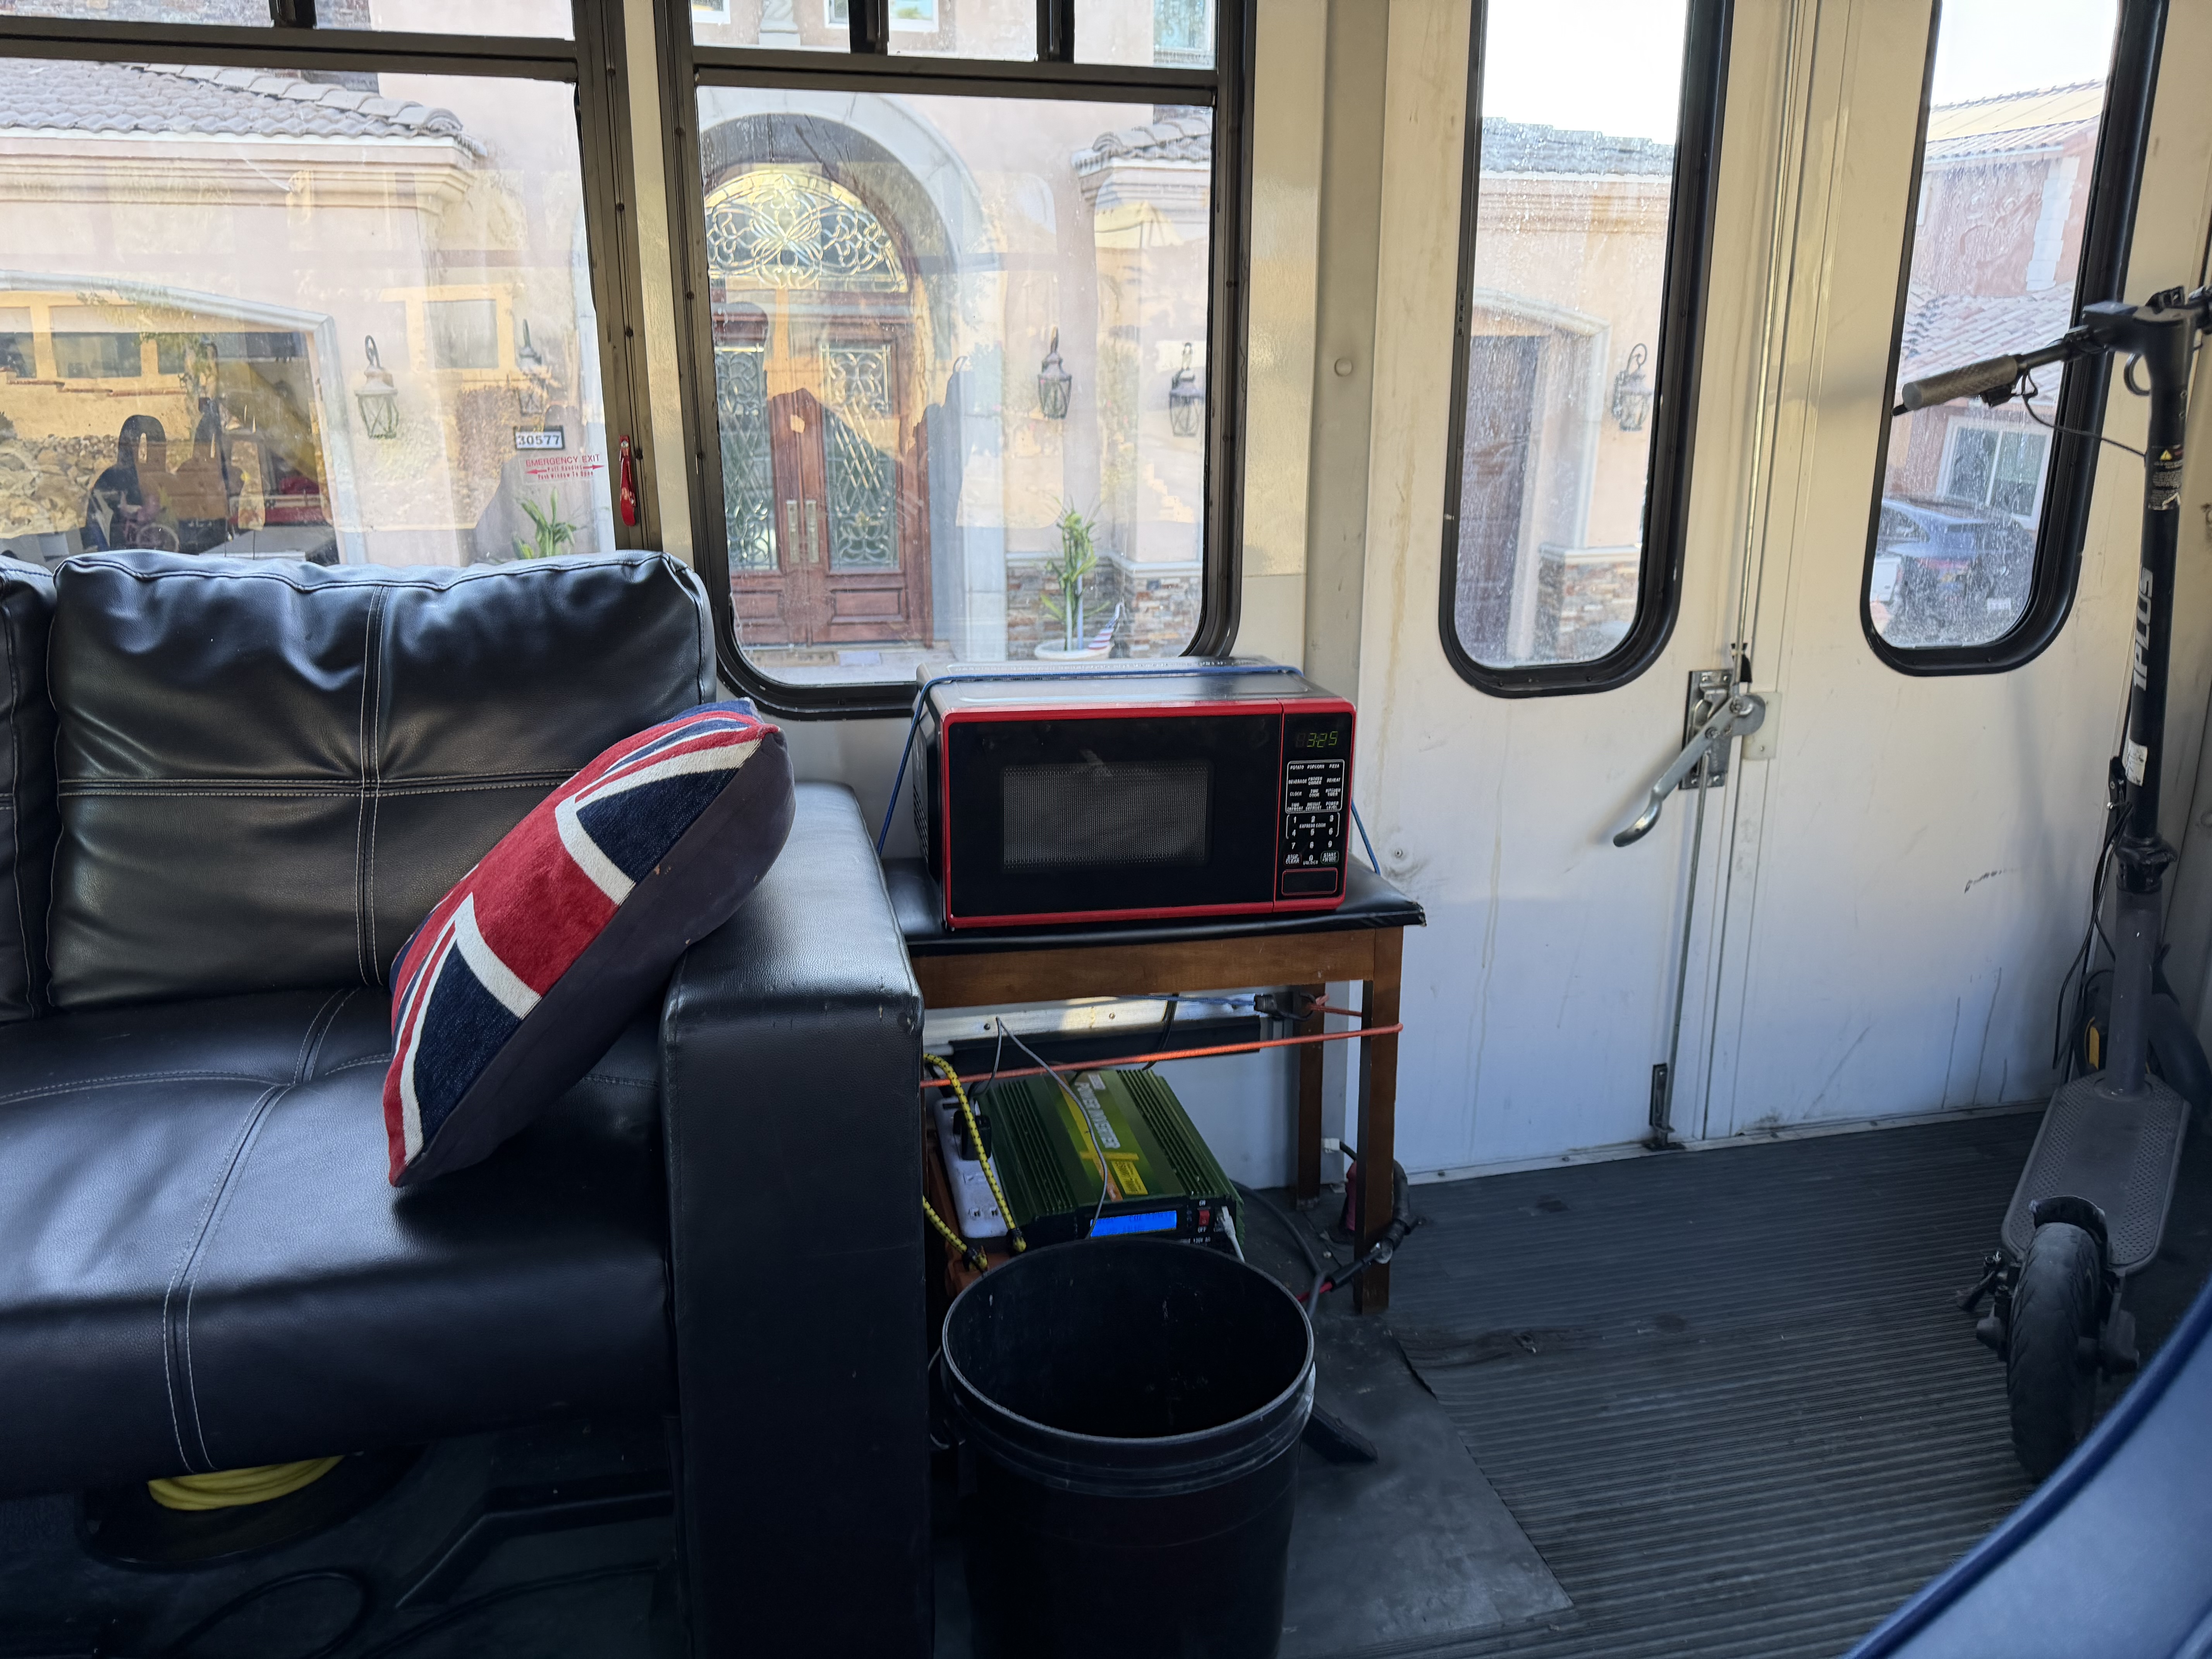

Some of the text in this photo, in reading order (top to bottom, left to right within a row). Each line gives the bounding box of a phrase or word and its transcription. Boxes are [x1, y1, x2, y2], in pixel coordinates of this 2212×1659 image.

[517, 434, 560, 445] 30577
[526, 454, 600, 467] EMERGENCY EXIT
